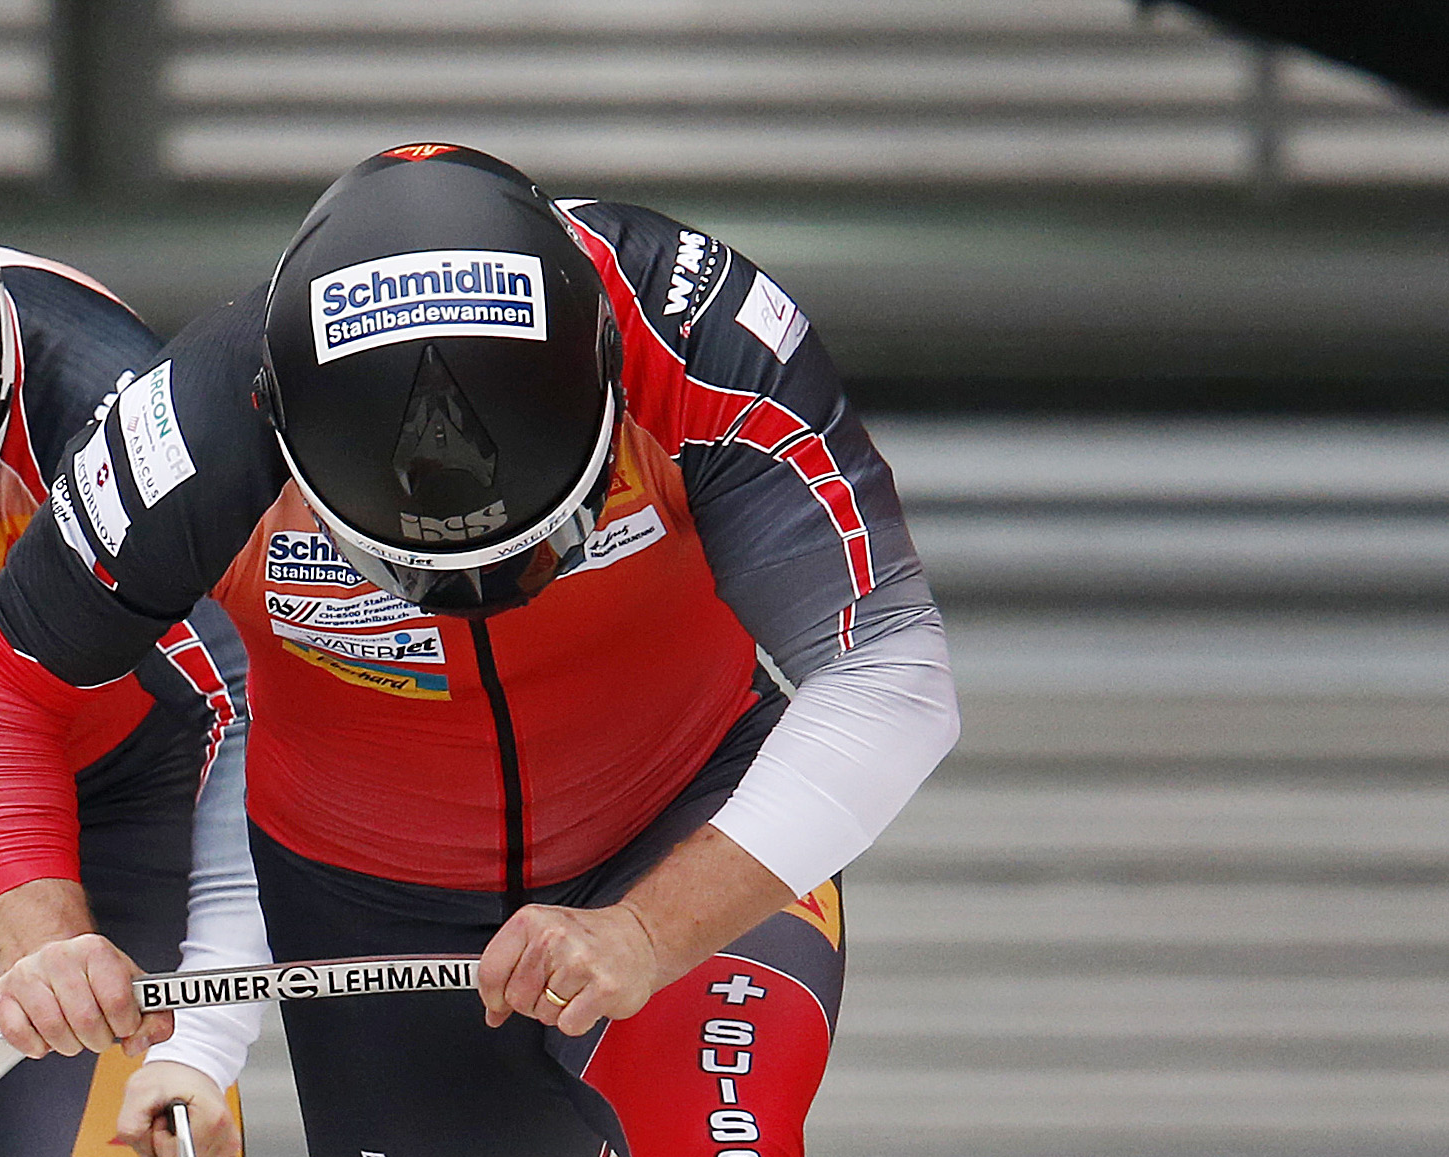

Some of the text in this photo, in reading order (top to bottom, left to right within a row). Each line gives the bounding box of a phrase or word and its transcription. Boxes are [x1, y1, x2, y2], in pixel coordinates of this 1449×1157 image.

[323, 261, 533, 317] Schmidlin
[328, 303, 531, 344] Stahlbadewannen
[150, 368, 191, 480] ARCON.CH
[143, 976, 271, 1008] BLUMER
